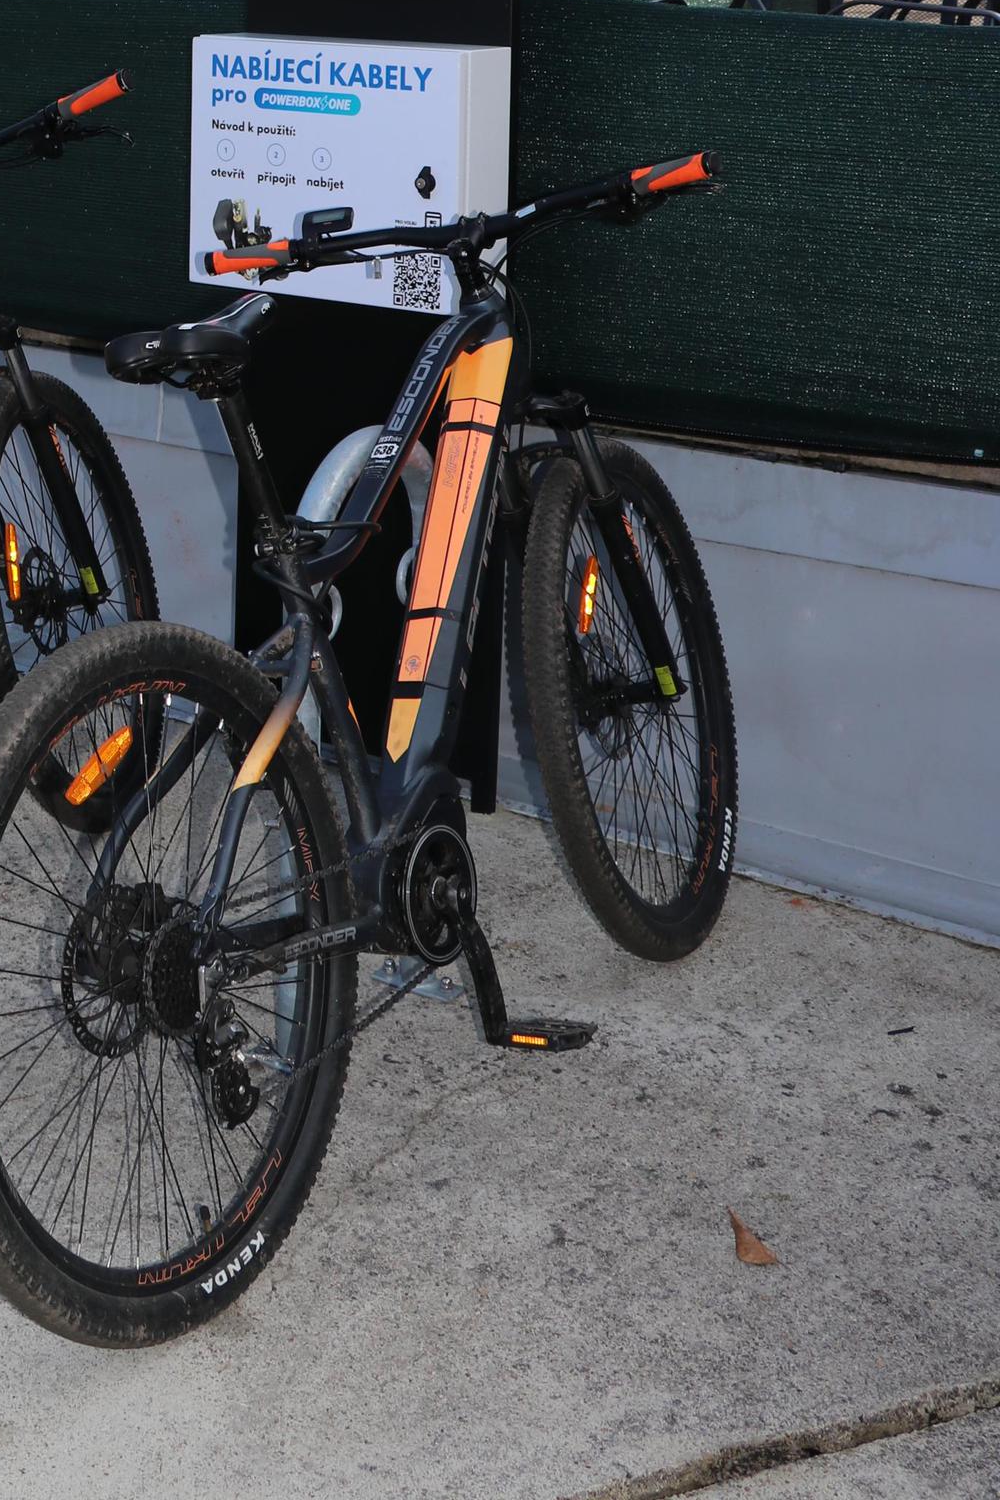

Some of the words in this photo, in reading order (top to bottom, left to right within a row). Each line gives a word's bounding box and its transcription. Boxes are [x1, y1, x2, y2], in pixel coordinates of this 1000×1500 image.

[211, 49, 322, 85] NABÍJECÍ
[330, 60, 433, 92] KABELY
[211, 88, 247, 107] pro
[261, 92, 321, 110] POWERBOX
[328, 98, 352, 111] ONE
[211, 119, 245, 132] Návod
[248, 122, 254, 133] k
[257, 124, 297, 137] použití:
[211, 167, 245, 180] otevřít
[257, 172, 297, 187] připojit
[306, 177, 345, 191] nabíjet
[373, 445, 393, 455] 638
[717, 806, 734, 873] KENDA
[200, 1230, 266, 1295] KENDA
